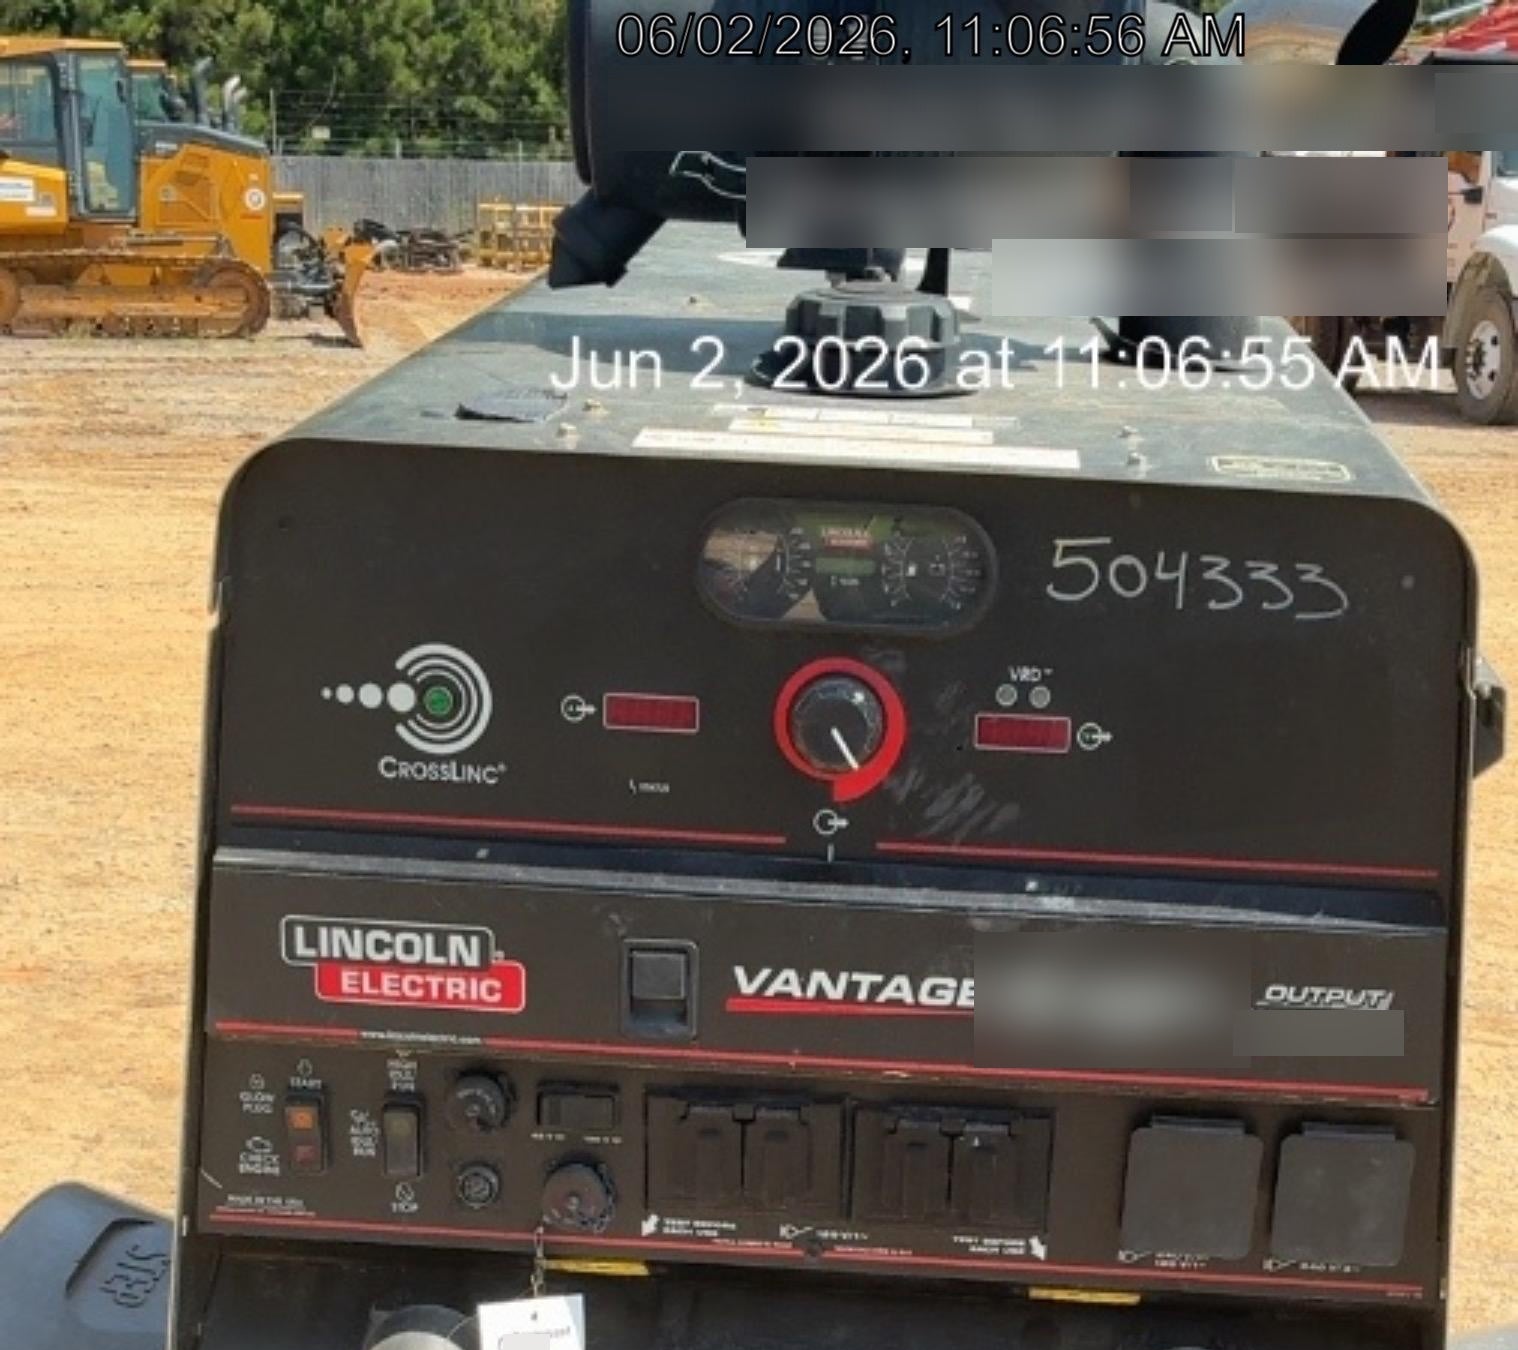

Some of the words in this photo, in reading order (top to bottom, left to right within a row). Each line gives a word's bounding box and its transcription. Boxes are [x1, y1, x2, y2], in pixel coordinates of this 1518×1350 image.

[1046, 536, 1349, 620] 504333
[294, 925, 482, 968] LINCOLN
[339, 970, 503, 1002] ELECTRIC
